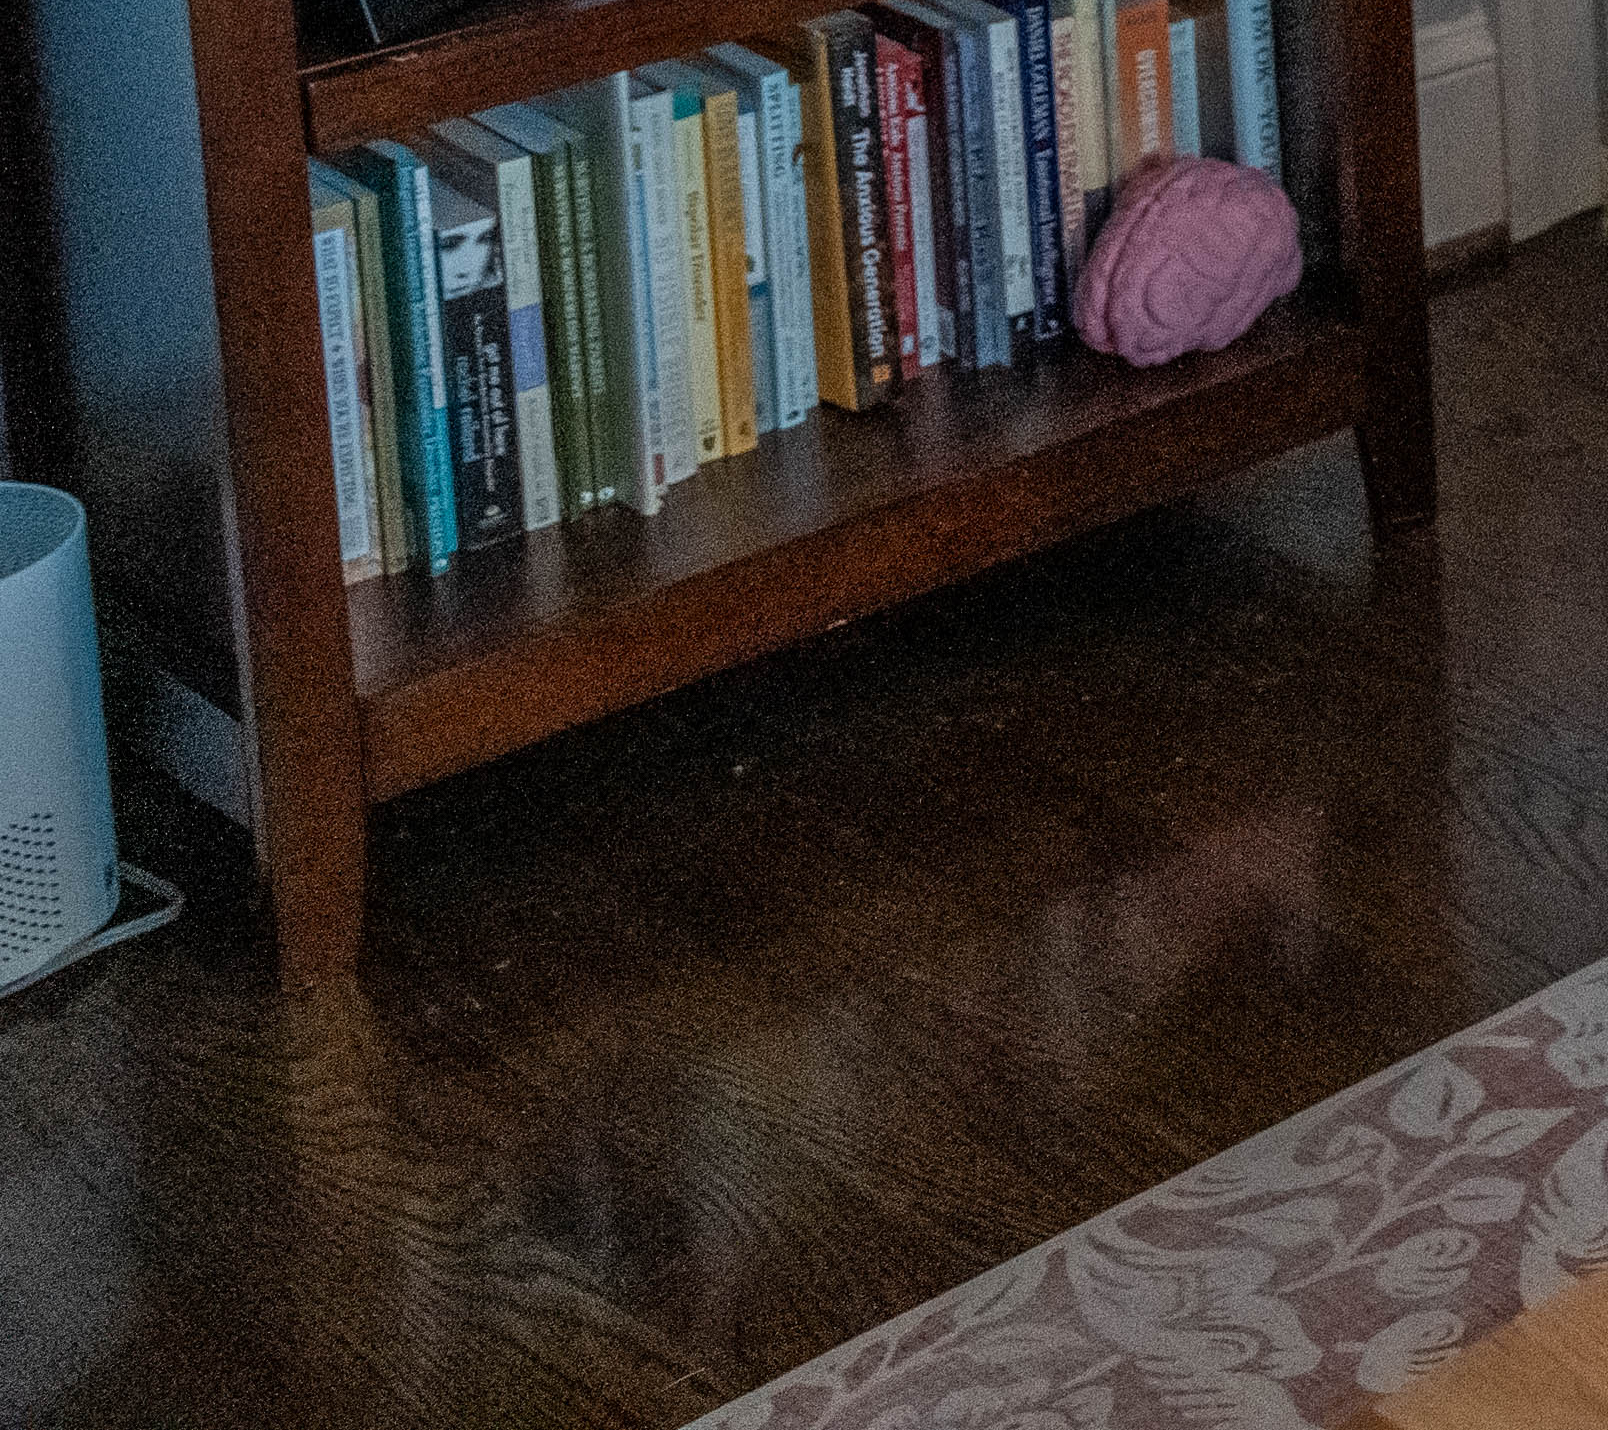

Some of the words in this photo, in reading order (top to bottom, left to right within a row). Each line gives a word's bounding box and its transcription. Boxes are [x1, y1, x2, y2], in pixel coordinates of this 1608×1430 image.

[1025, 6, 1046, 59] DANIEL
[1250, 4, 1270, 38] I'M
[851, 50, 872, 117] Jonathan
[884, 62, 900, 113] Anxious
[1028, 59, 1051, 141] GOLEMAN
[766, 82, 787, 179] SPLITTING
[850, 127, 870, 167] The
[890, 151, 905, 201] Anxious
[1034, 149, 1056, 222] Emotional
[683, 190, 703, 250] Bipolar
[852, 169, 877, 246] Anxious
[893, 203, 908, 251] Parents
[318, 235, 338, 272] WHAT
[653, 234, 673, 264] NO
[1036, 223, 1060, 305] Intelligence
[323, 293, 344, 339] EXPECT
[656, 272, 680, 347] VISIBLE
[690, 253, 708, 323] Disorder
[858, 248, 887, 359] Generation
[329, 356, 349, 396] WHEN
[482, 342, 501, 363] get
[661, 357, 688, 447] BRUISES
[491, 424, 511, 456] here
[336, 442, 358, 509] EXPECTING
